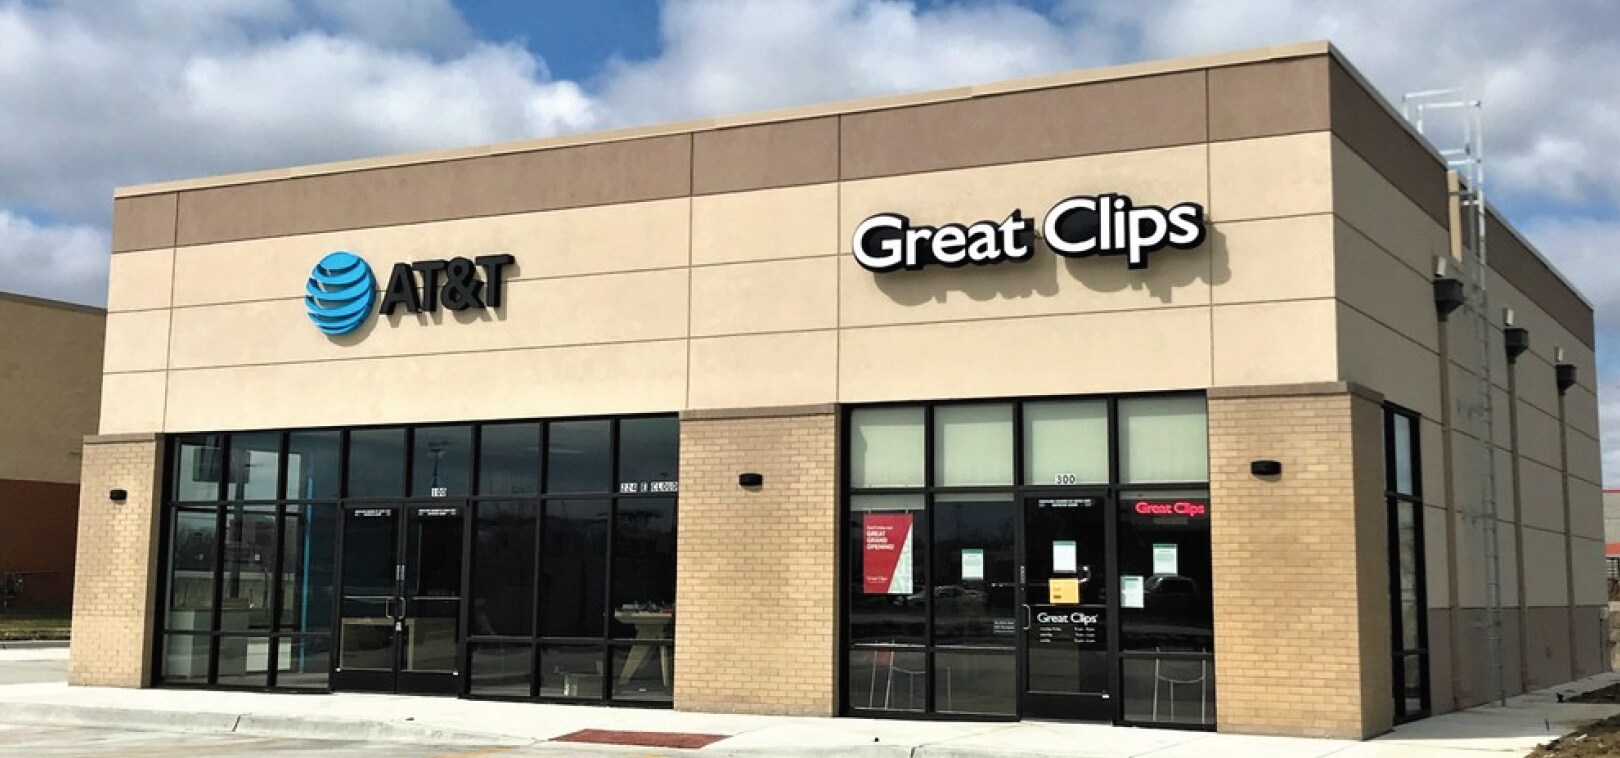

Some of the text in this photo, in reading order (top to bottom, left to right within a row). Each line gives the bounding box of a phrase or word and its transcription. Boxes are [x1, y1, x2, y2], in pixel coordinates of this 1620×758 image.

[852, 194, 1204, 271] Great Clips
[379, 254, 515, 314] AT&T
[1055, 474, 1076, 485] 300
[1135, 502, 1205, 517] Great Clips
[1037, 612, 1097, 626] Great Clips
